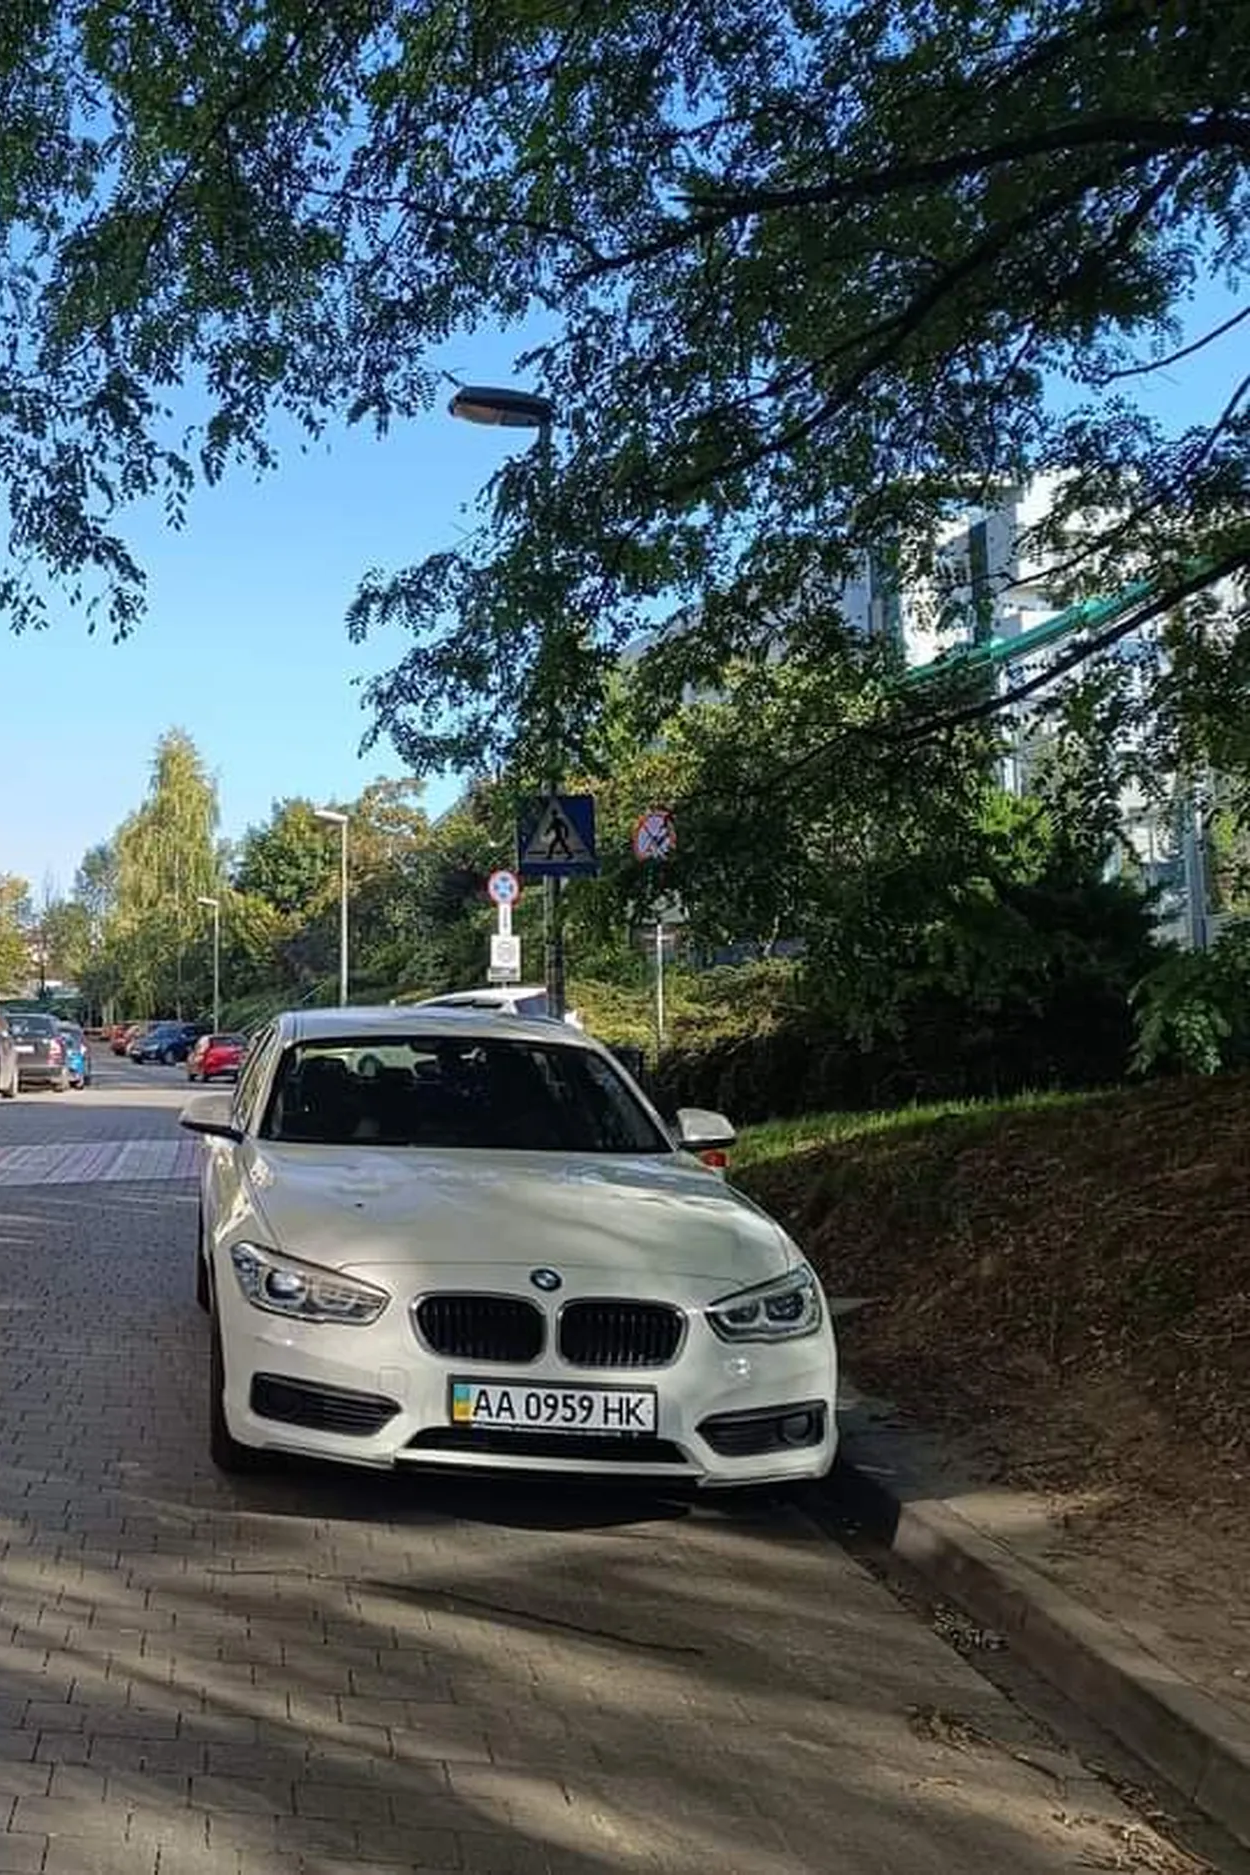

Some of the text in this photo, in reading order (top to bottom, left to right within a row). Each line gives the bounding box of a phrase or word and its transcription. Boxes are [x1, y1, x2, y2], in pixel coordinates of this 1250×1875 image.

[473, 1389, 646, 1427] AA 0959 HK
